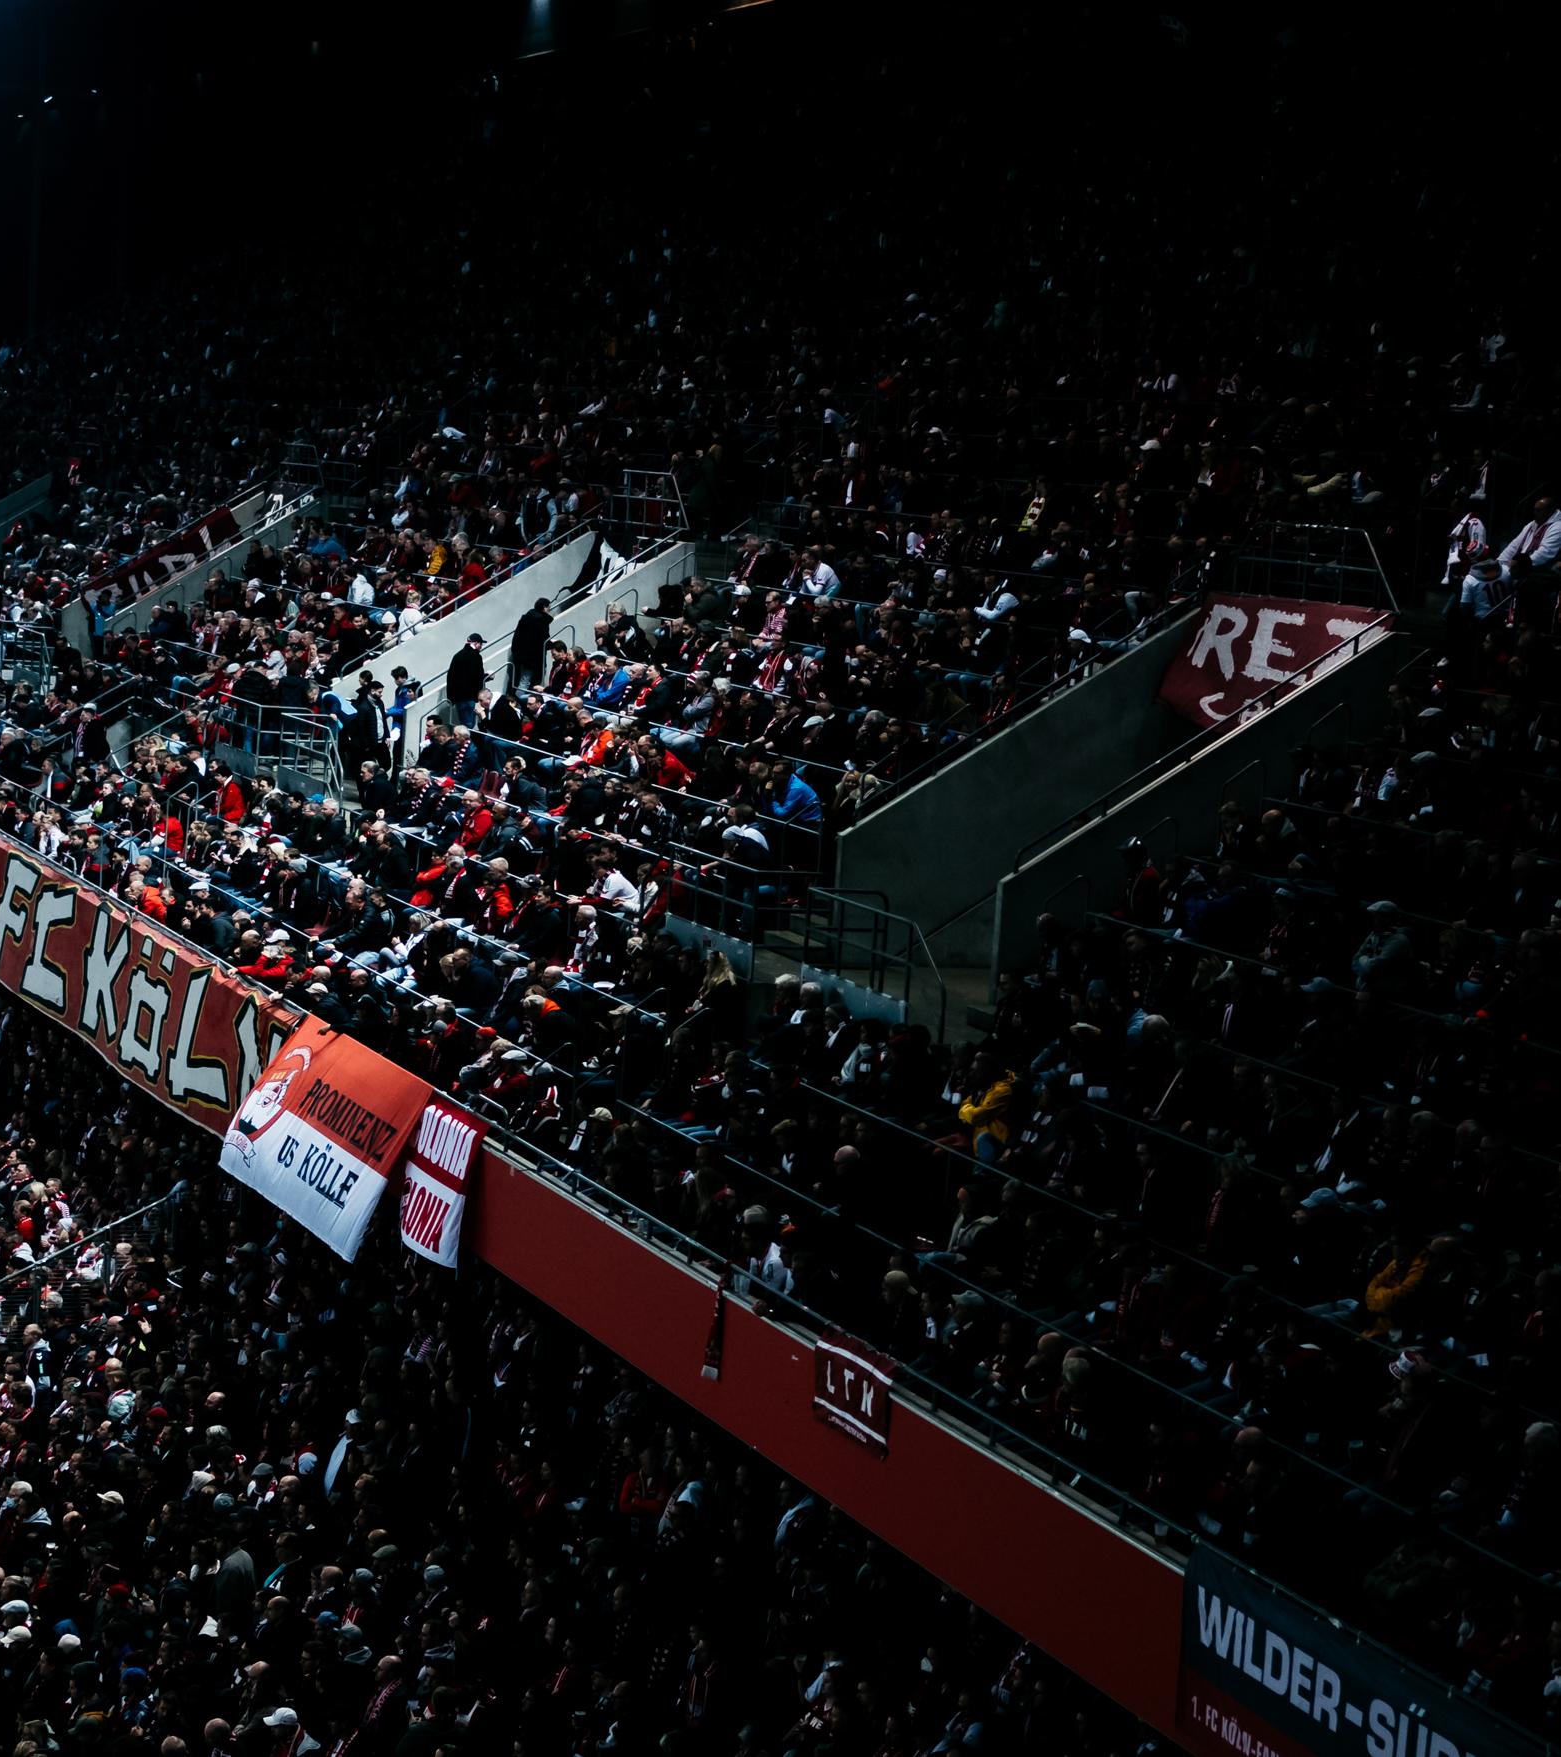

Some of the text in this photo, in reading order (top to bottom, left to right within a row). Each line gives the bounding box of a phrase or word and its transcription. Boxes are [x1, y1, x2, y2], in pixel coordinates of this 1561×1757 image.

[298, 1078, 398, 1162] PROMINENZ
[413, 1104, 477, 1181] OLONIA
[297, 1143, 360, 1210] KÖLLE
[1198, 1584, 1476, 1757] WILDER-SÜ
[1191, 1695, 1201, 1721] 1.
[1205, 1704, 1218, 1733] FC
